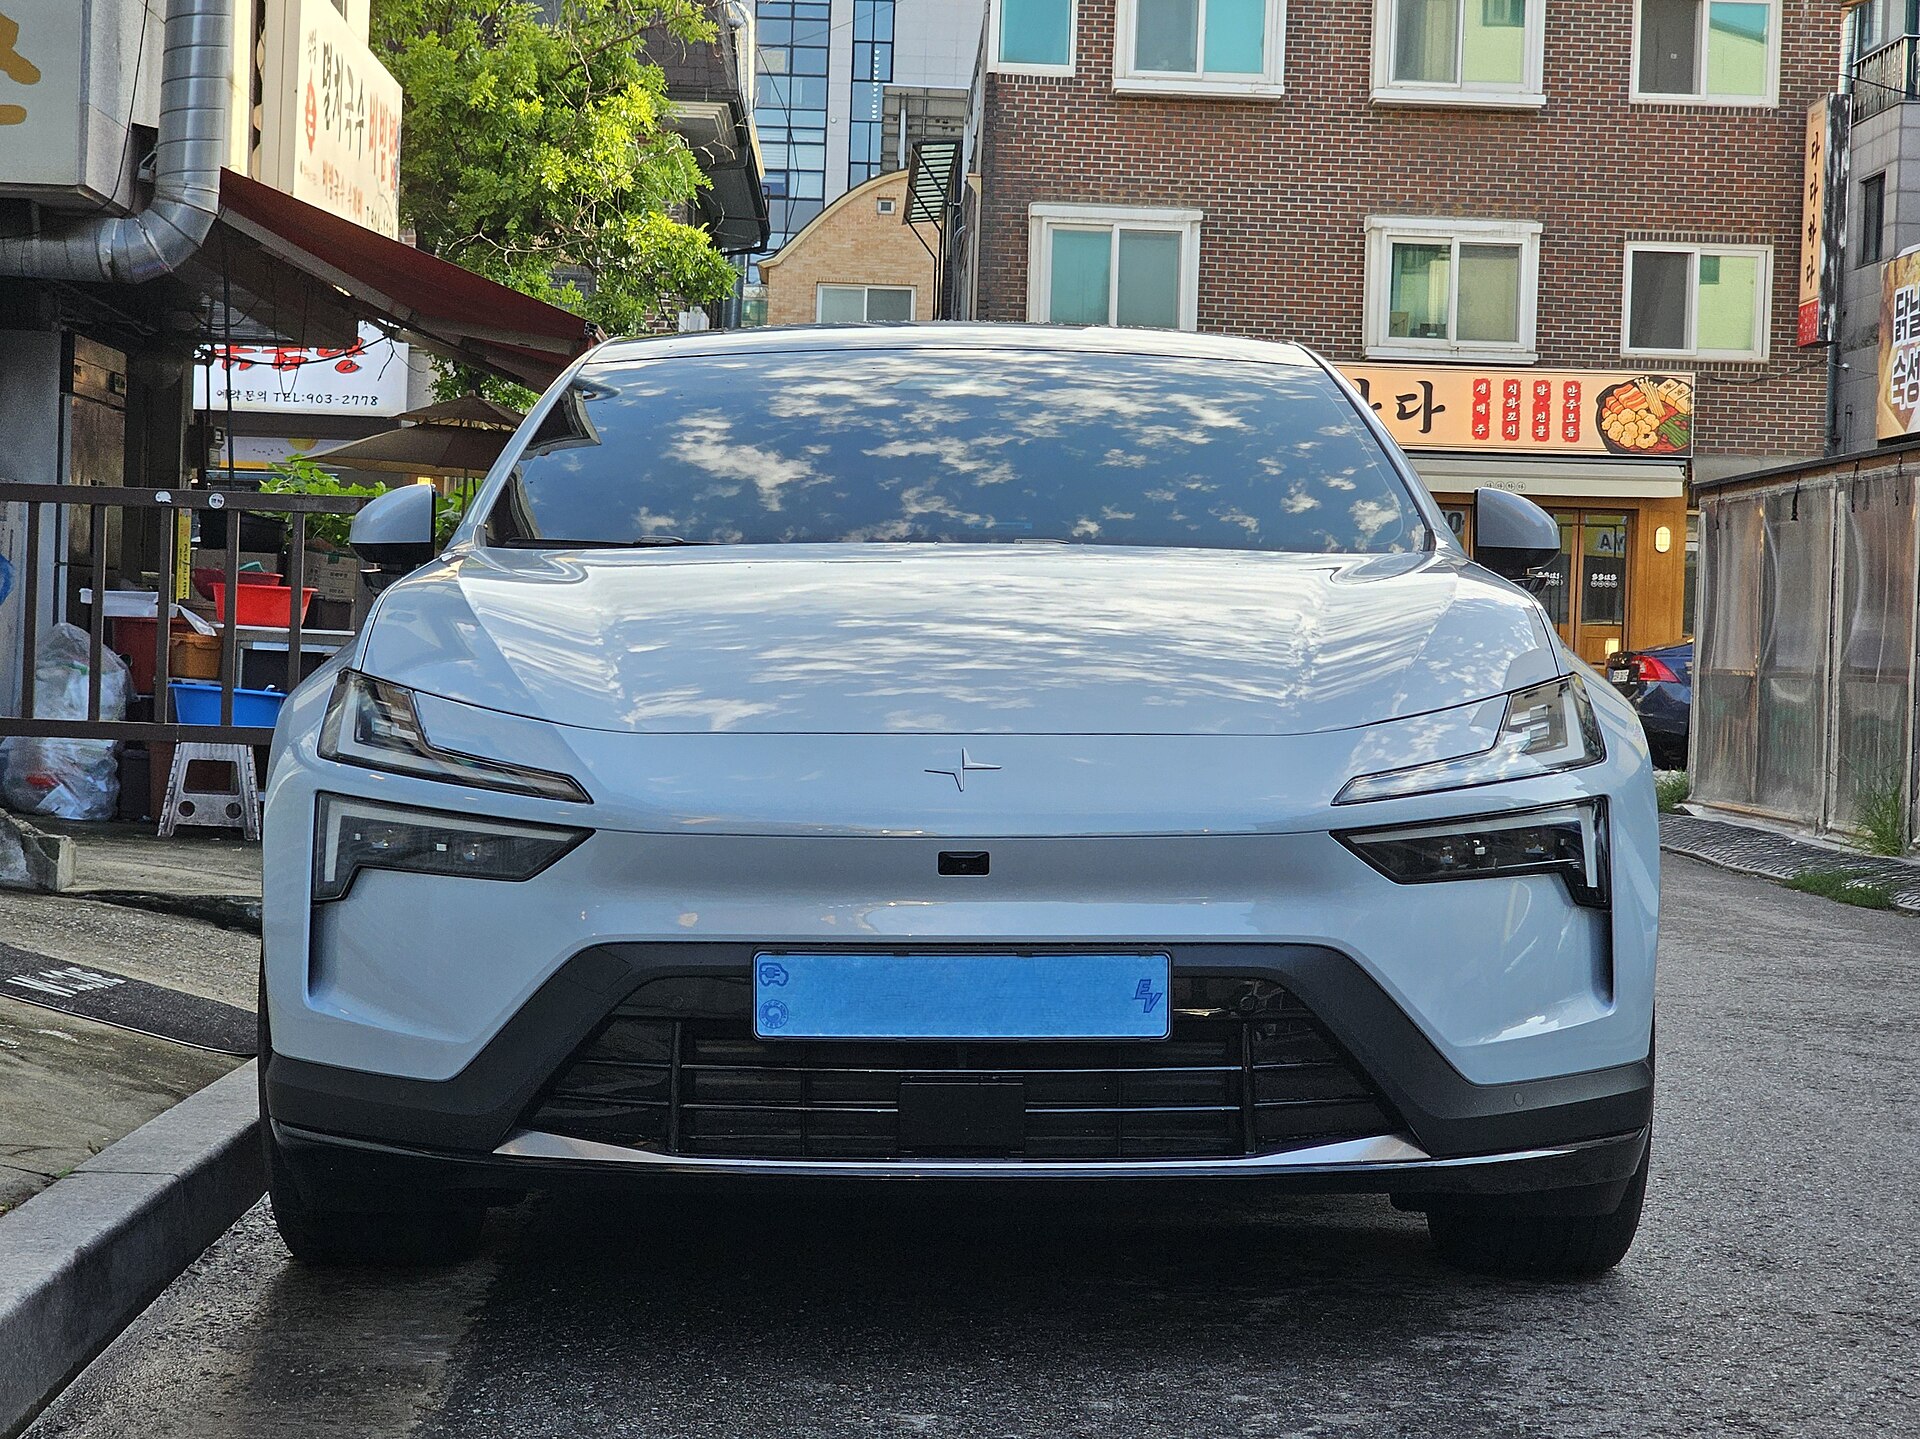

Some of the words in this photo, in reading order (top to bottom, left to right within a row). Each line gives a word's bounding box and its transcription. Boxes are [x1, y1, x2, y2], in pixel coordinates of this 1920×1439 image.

[322, 42, 365, 161] 멸치국수
[1806, 131, 1820, 290] 다다하다
[1475, 383, 1487, 435] 생맥주
[1506, 383, 1518, 436] 직화꼬치
[1134, 979, 1163, 1013] EV
